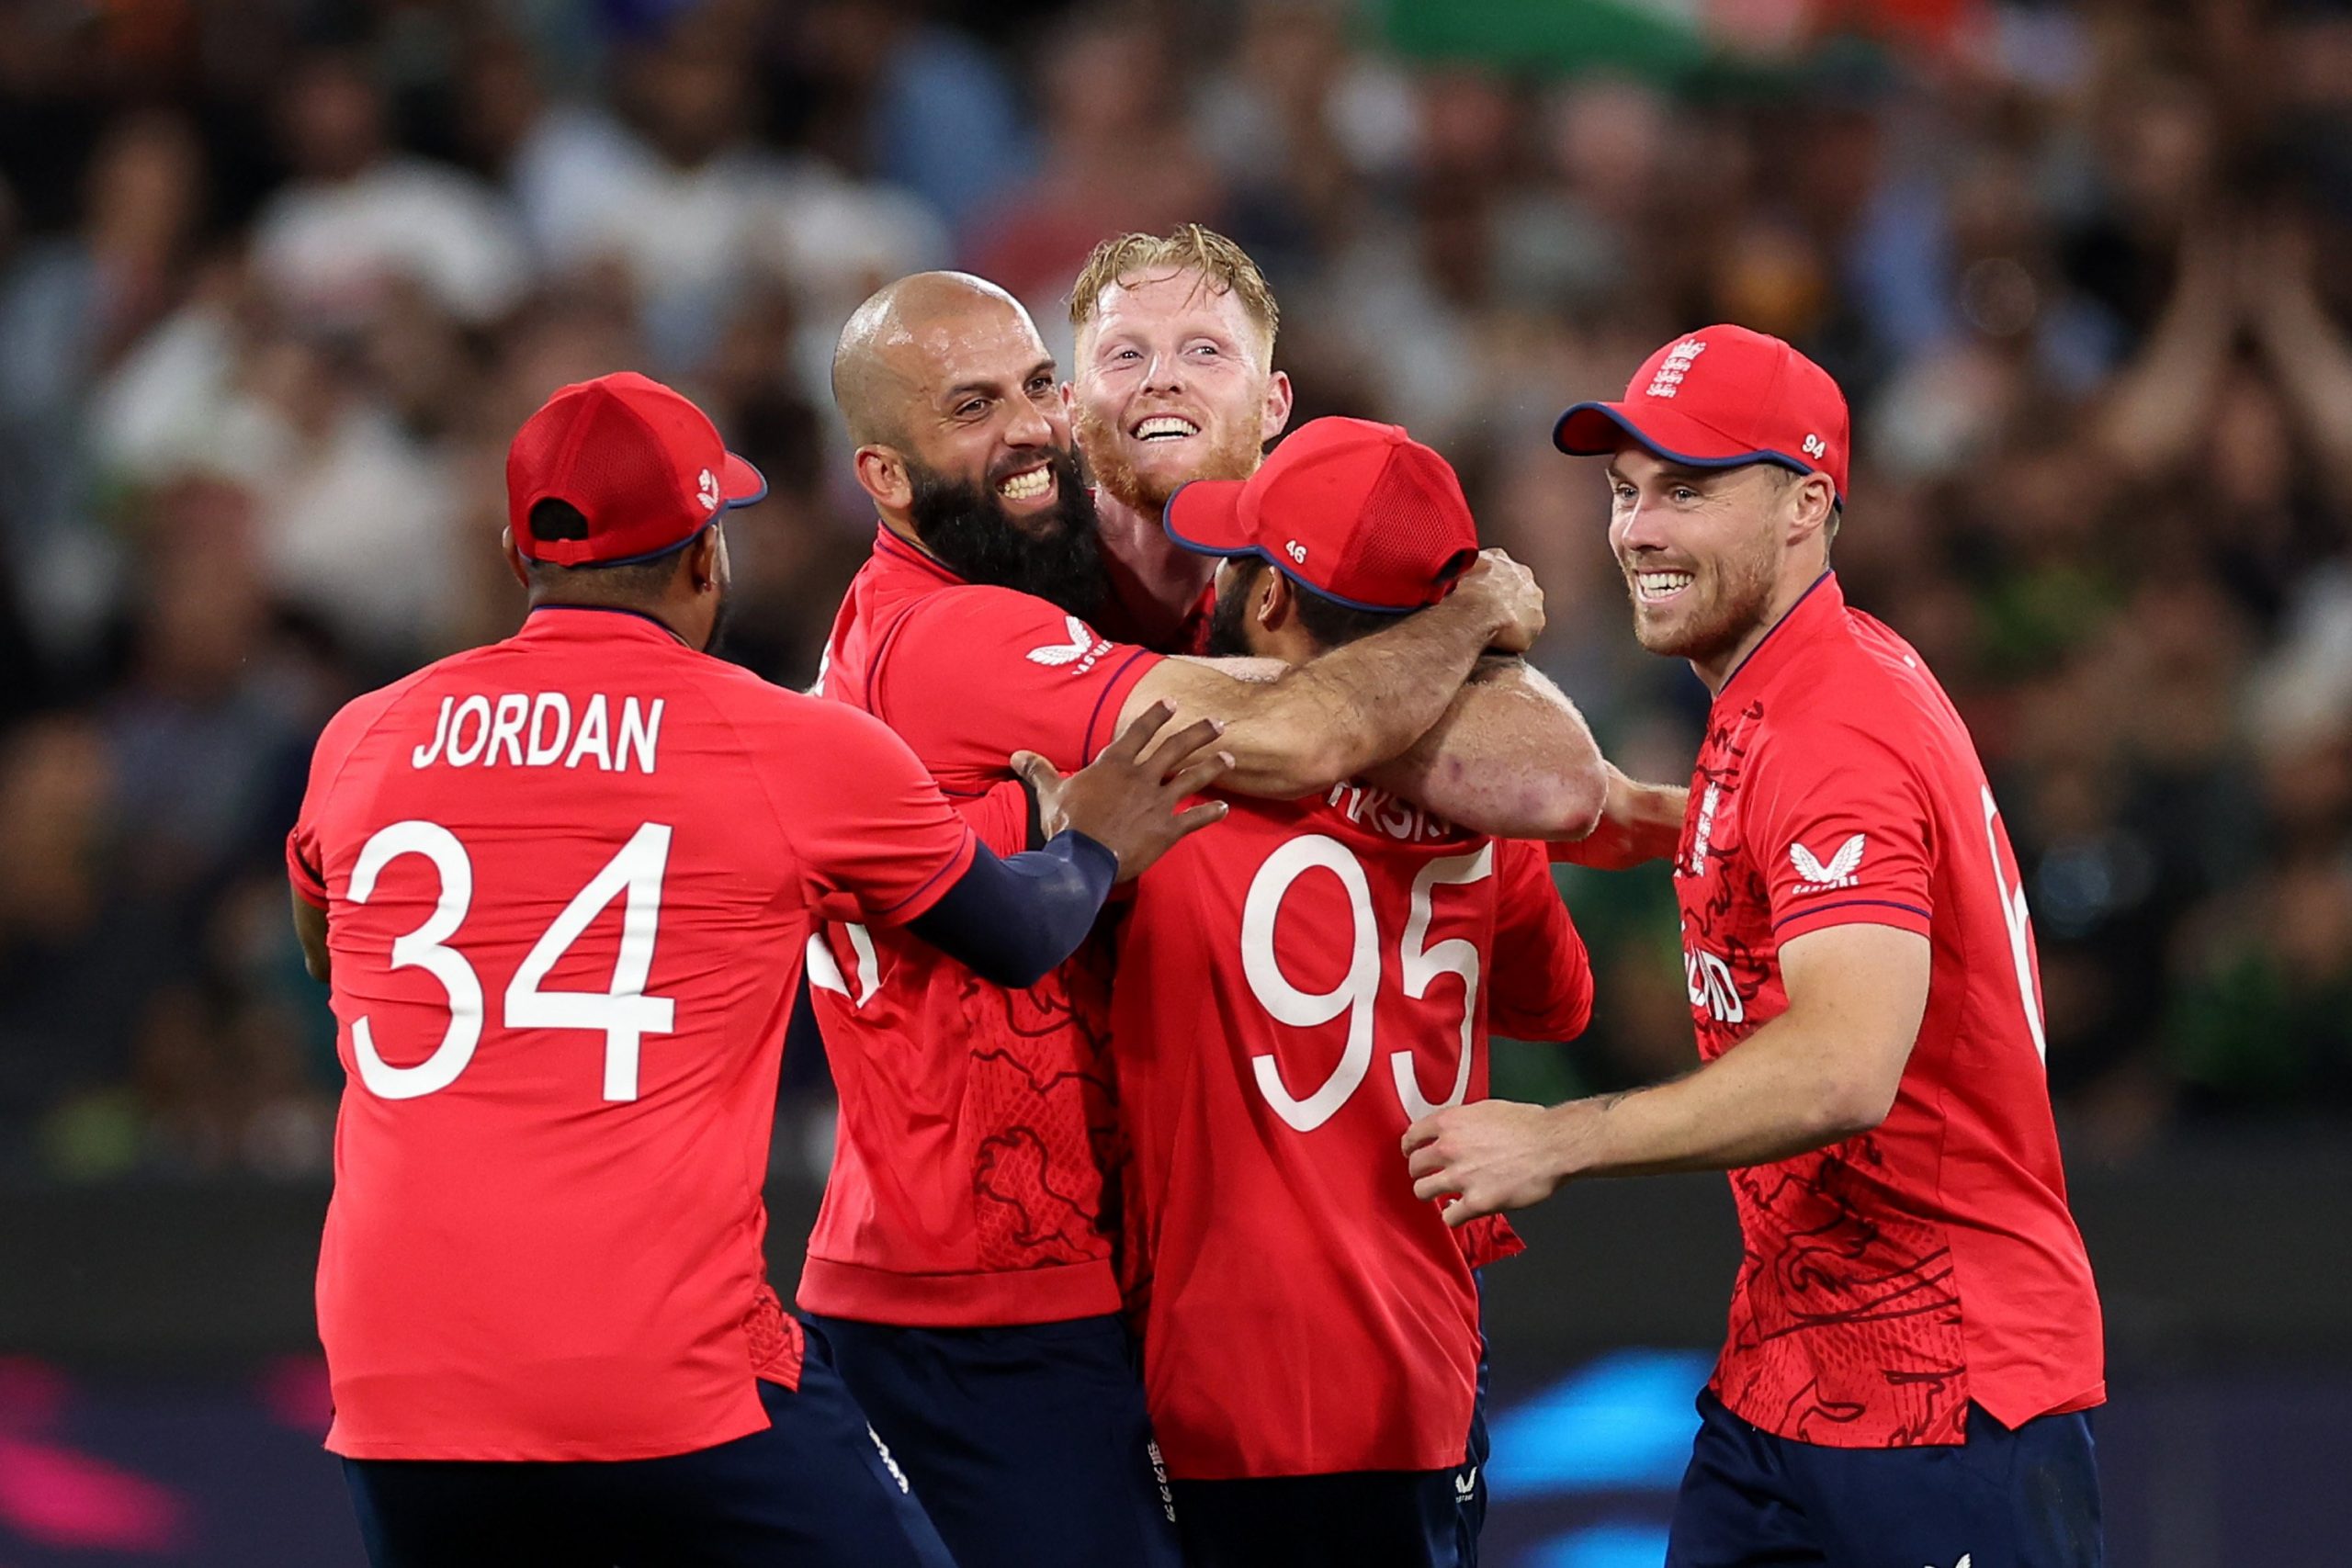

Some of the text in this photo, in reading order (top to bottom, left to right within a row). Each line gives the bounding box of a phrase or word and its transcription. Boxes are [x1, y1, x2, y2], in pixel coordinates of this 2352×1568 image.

[1803, 434, 1826, 459] 94
[1286, 540, 1306, 564] 46
[412, 692, 665, 773] JORDAN
[346, 819, 675, 1102] 34
[1241, 834, 1493, 1132] 95
